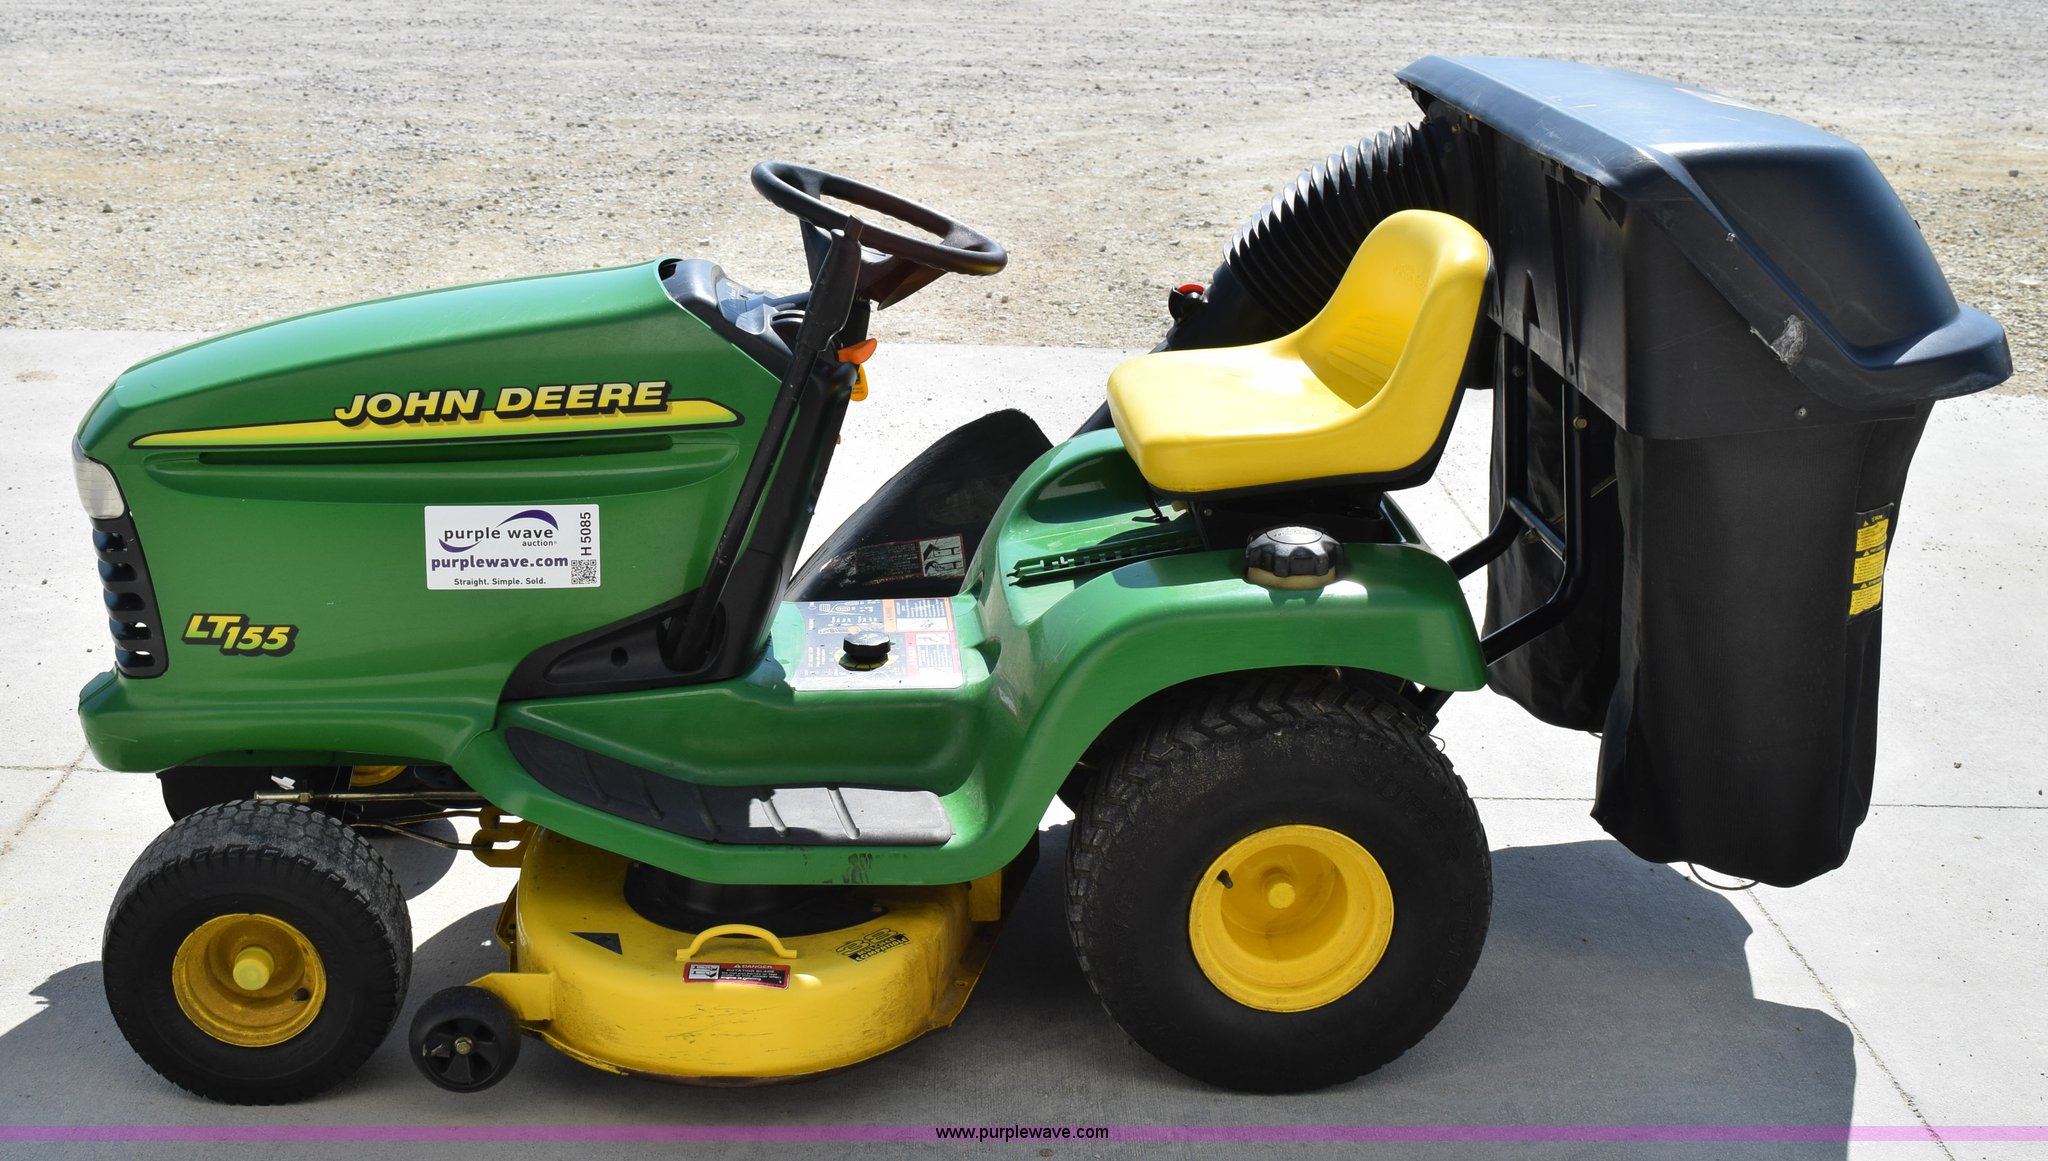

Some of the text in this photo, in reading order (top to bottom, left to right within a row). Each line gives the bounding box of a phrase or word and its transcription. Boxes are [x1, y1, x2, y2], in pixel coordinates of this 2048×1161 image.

[334, 380, 669, 423] JOHN DEERE
[444, 527, 554, 542] purple wave
[579, 511, 592, 556] H 5085
[521, 539, 554, 547] auction
[431, 555, 569, 571] purplewave.com
[453, 577, 546, 587] Straight. Simple. Sold.
[855, 937, 908, 961] COMPATIBLE
[857, 937, 896, 956] MULCHER
